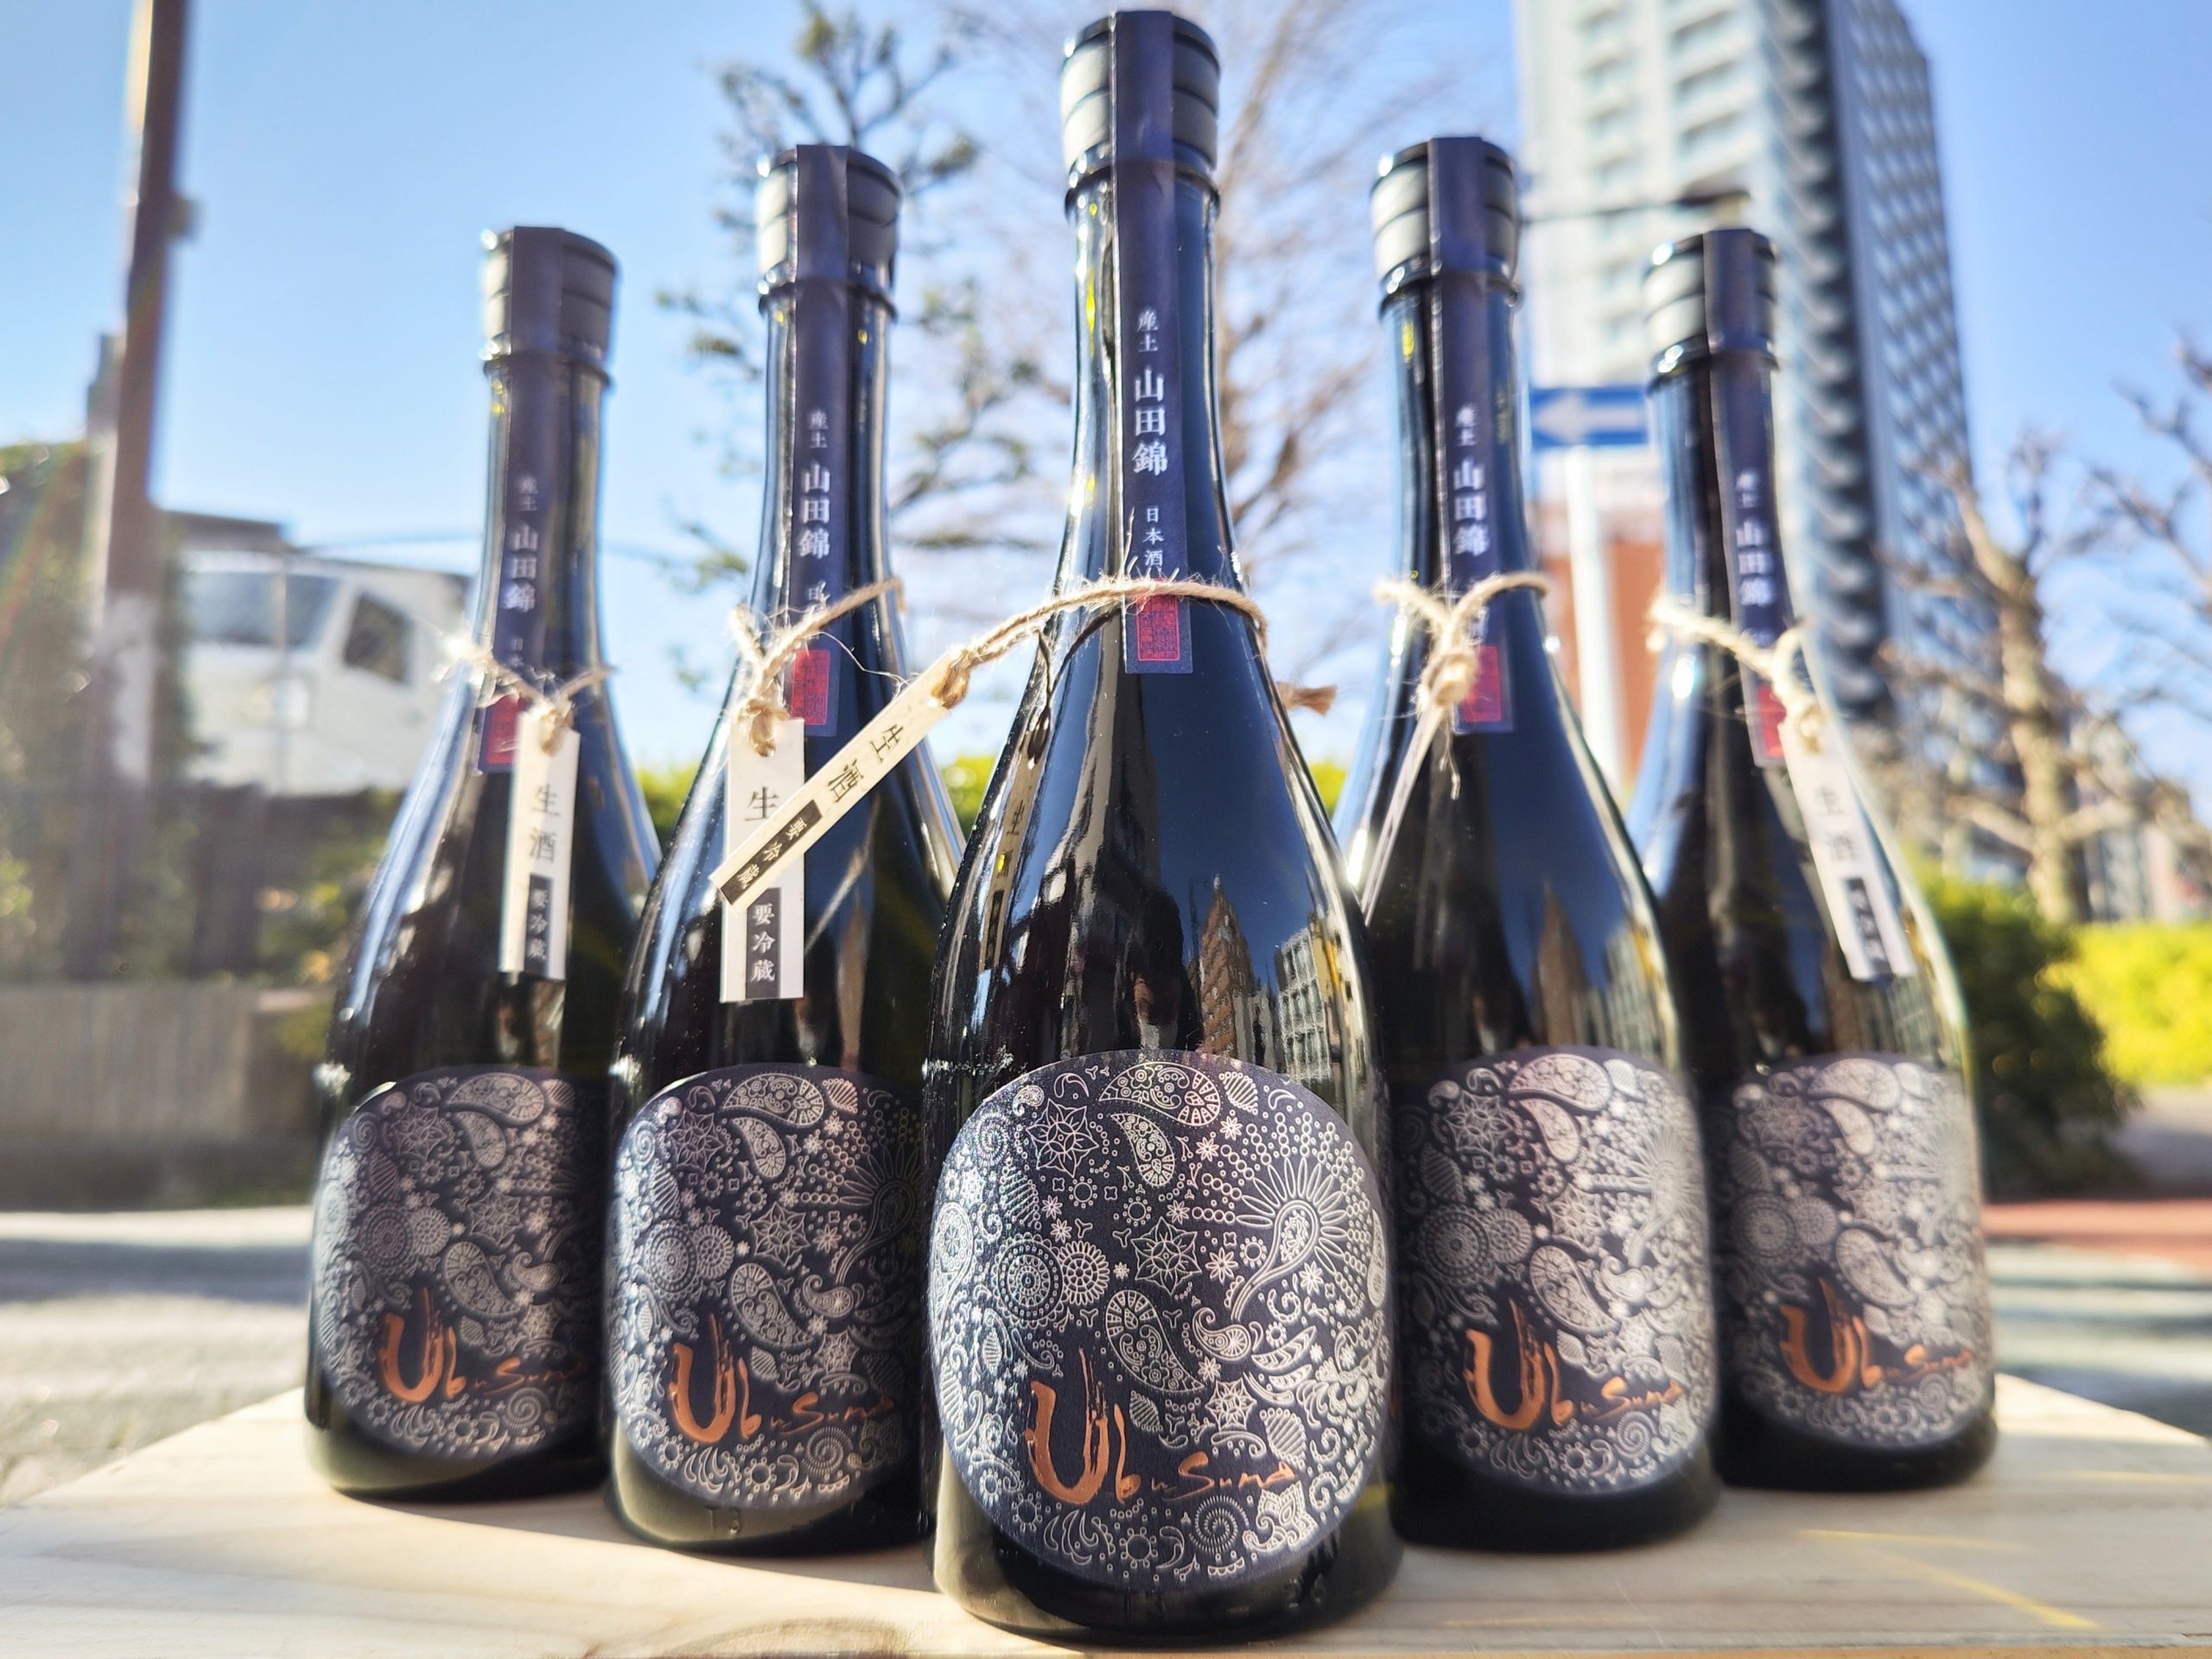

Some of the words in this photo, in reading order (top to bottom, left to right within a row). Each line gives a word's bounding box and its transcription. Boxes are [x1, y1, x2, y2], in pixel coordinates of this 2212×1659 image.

[1136, 307, 1159, 353] 産土
[1132, 365, 1168, 477] 山田錦
[799, 458, 831, 560] 山田錦
[1142, 506, 1164, 567] 日本酒
[1452, 455, 1491, 557] 山田錦
[503, 520, 539, 613] 山田錦
[826, 723, 905, 804] 生酒
[529, 781, 562, 864] 生酒
[750, 902, 777, 983] 要冷蔵
